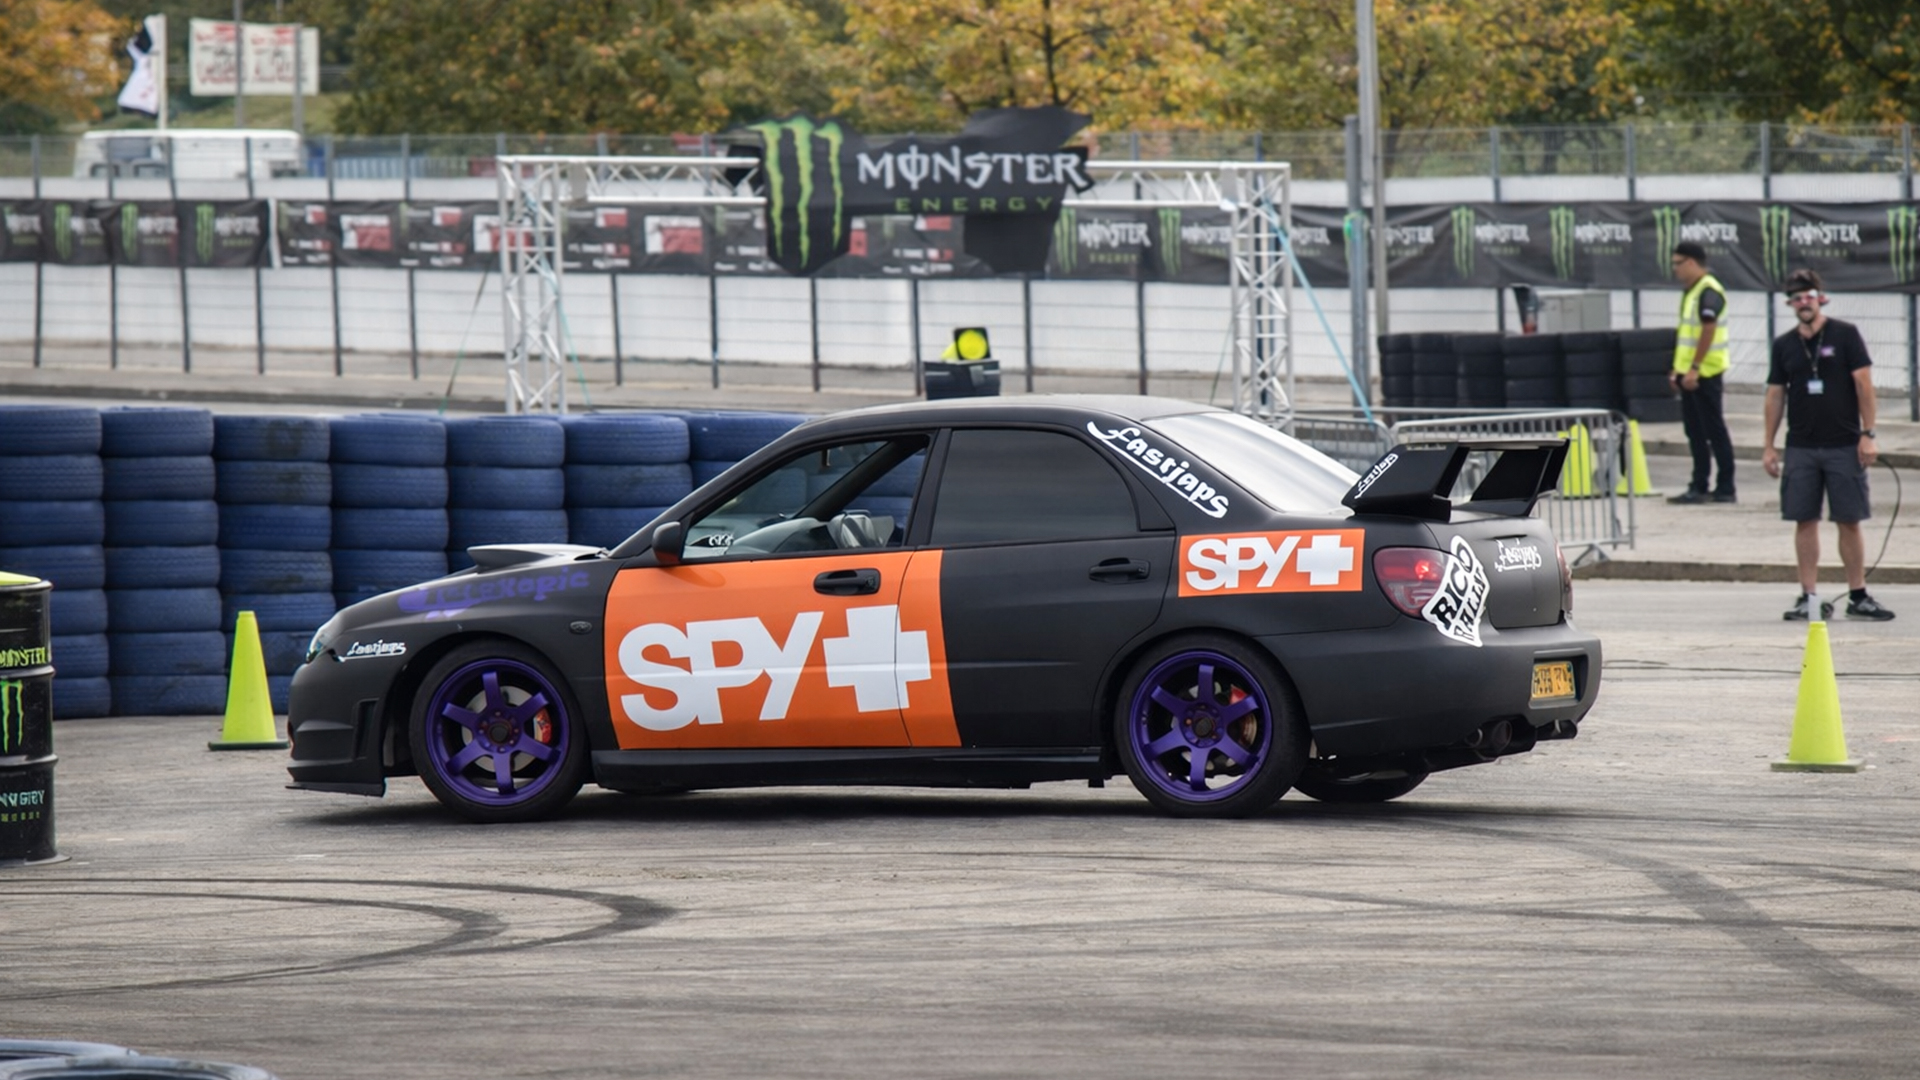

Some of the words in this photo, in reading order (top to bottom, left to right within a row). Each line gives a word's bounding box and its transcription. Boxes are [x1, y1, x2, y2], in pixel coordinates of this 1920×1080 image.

[856, 145, 1088, 191] MONSTER
[894, 196, 1053, 212] ENERGY
[1430, 543, 1474, 631] RICO
